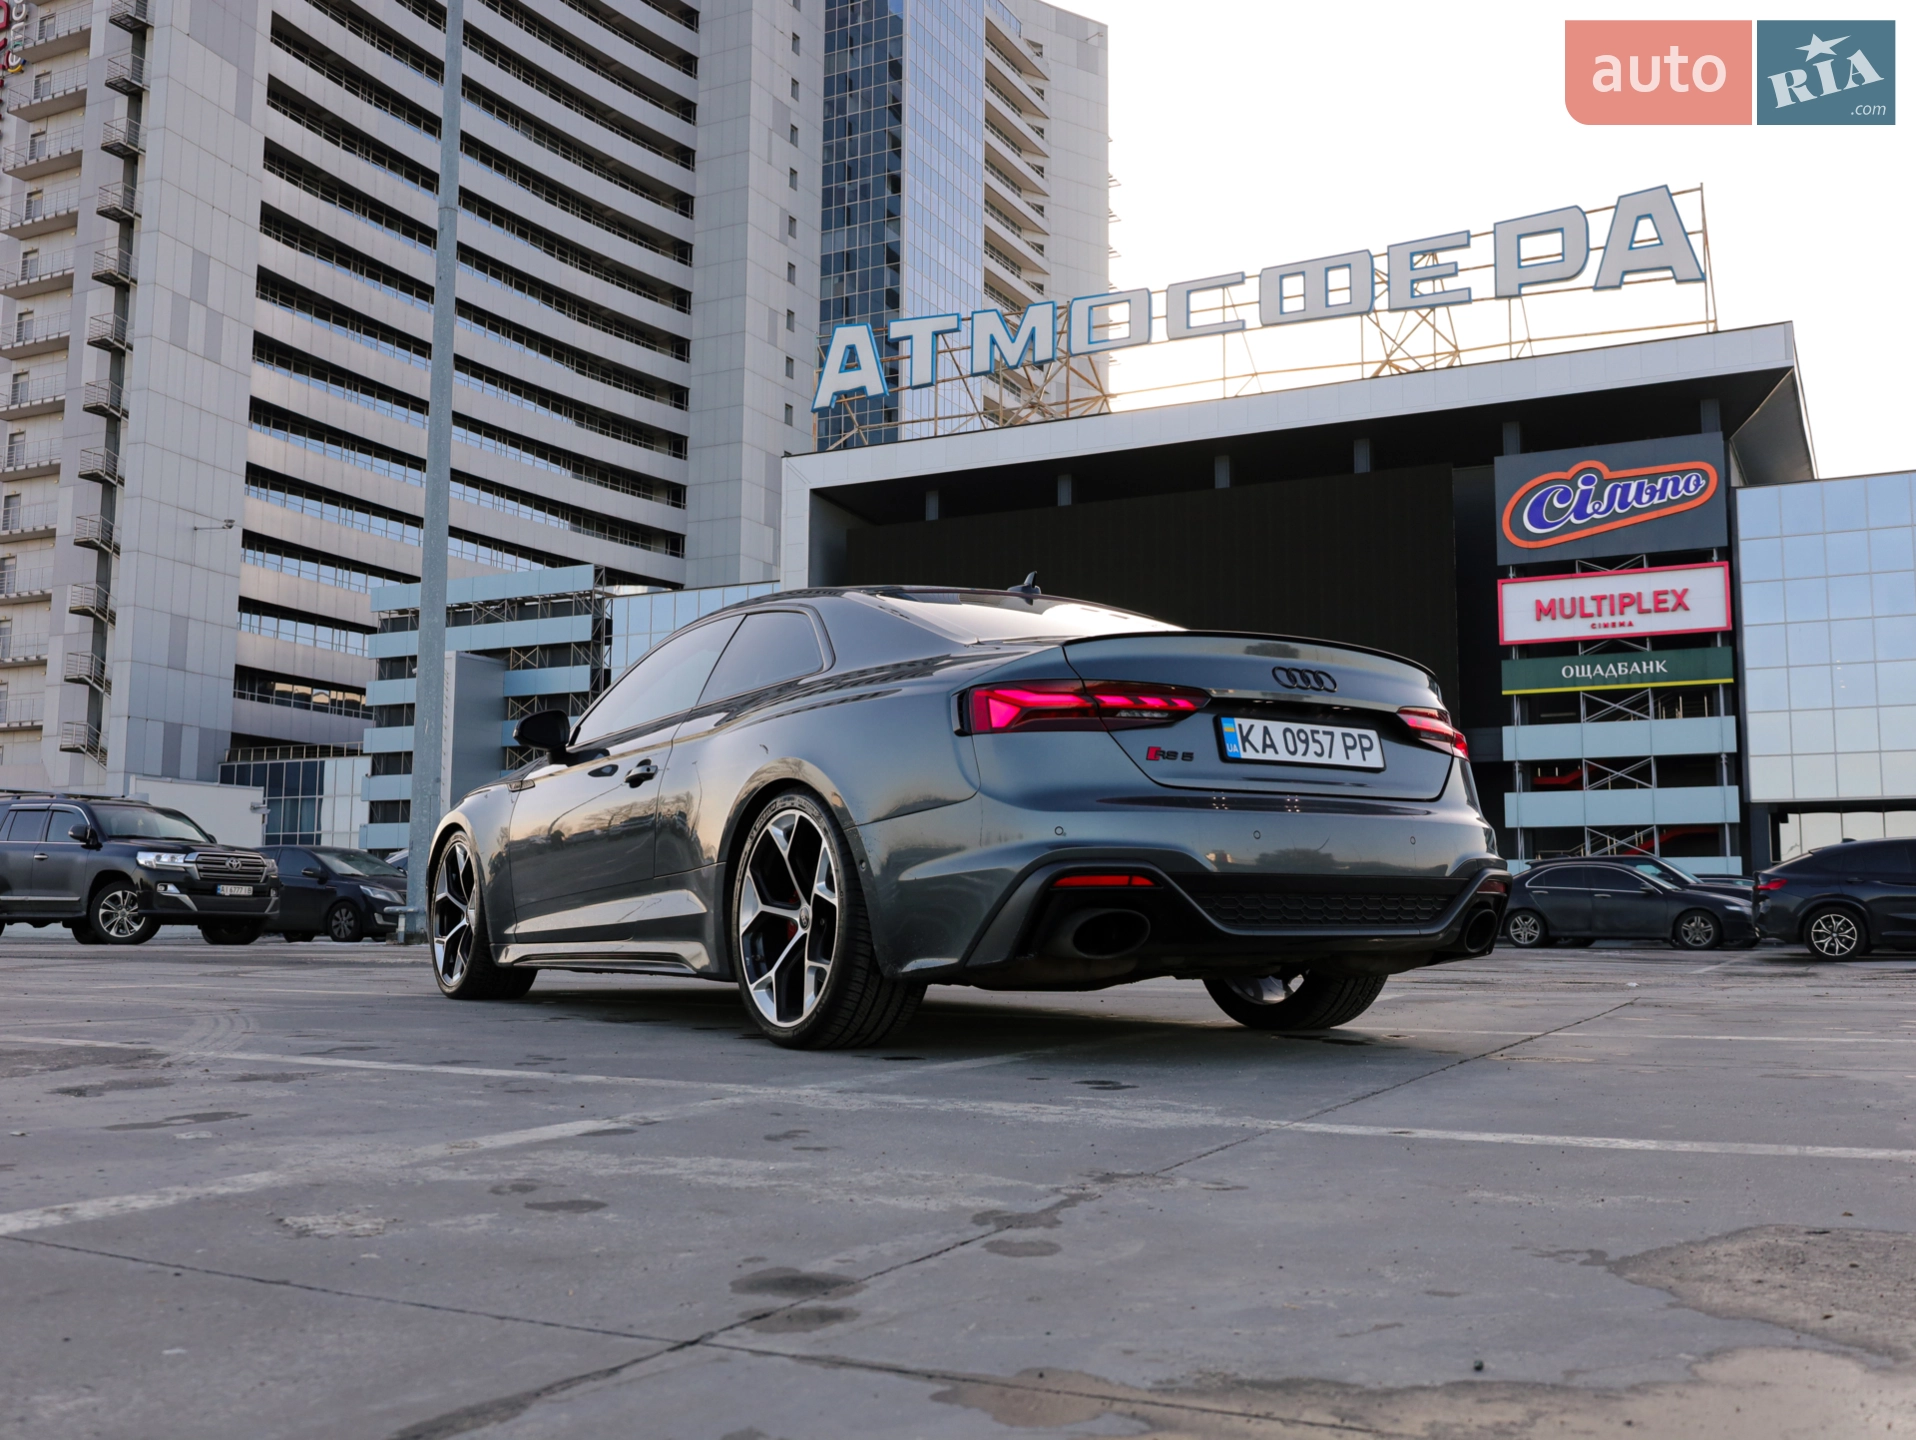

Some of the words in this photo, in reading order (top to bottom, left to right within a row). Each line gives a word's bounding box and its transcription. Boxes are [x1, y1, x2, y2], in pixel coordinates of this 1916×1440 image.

[811, 184, 1706, 413] АТМОСФЕРА
[1523, 473, 1706, 534] Сільпо
[1534, 588, 1690, 621] MULTIPLEX
[1590, 620, 1634, 630] CINEMA
[1561, 659, 1668, 680] ОЩАДБАНК
[1226, 743, 1239, 753] UA
[1237, 723, 1279, 755] KA
[1283, 728, 1335, 759] 0957
[1341, 732, 1374, 761] PP
